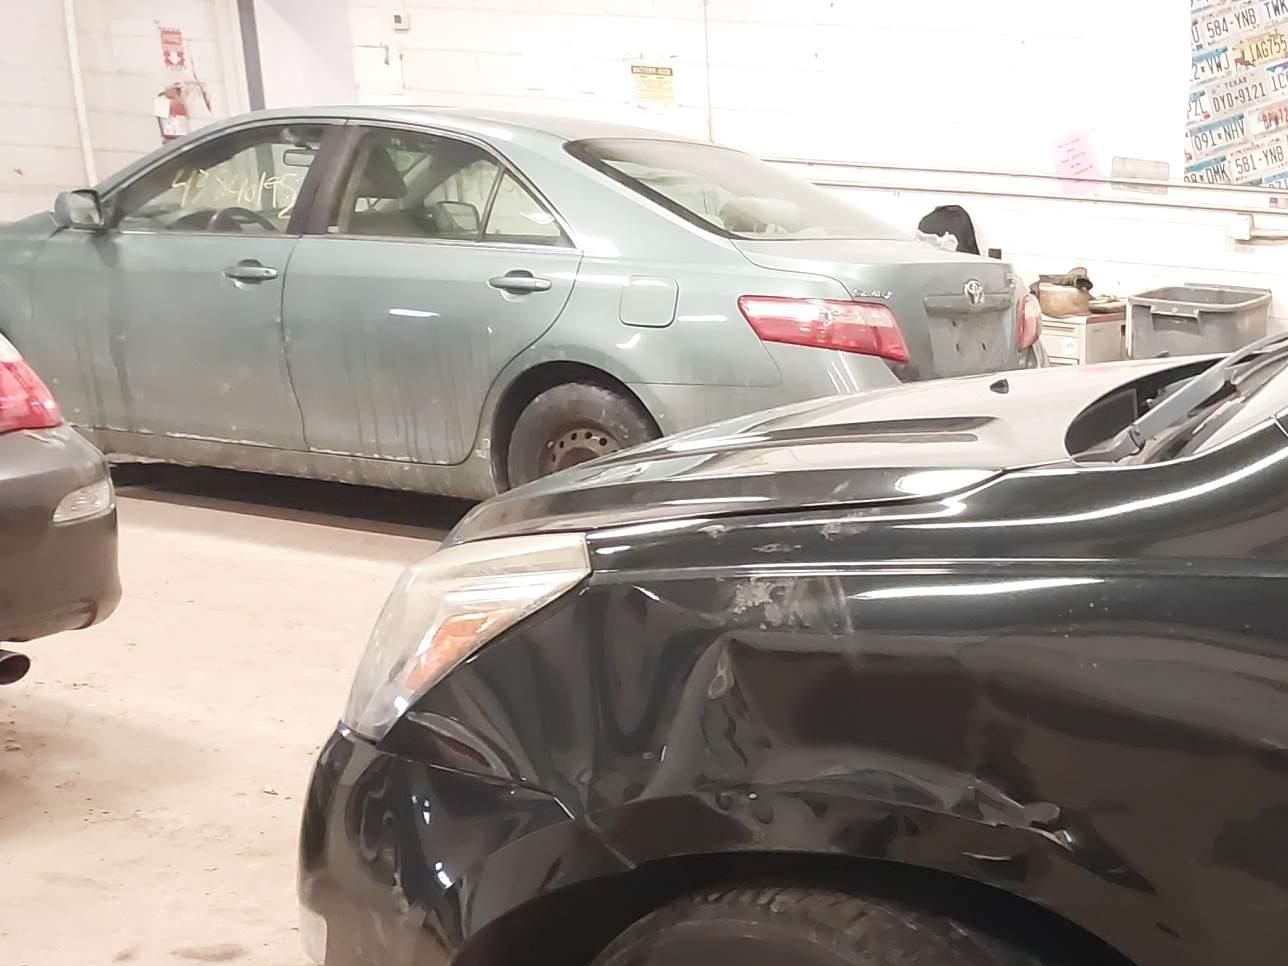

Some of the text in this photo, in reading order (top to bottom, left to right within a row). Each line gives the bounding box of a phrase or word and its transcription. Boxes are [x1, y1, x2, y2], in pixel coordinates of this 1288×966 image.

[1206, 7, 1257, 39] 584-YNB
[1224, 76, 1248, 90] TEXAS
[1234, 145, 1285, 175] 581-YNB
